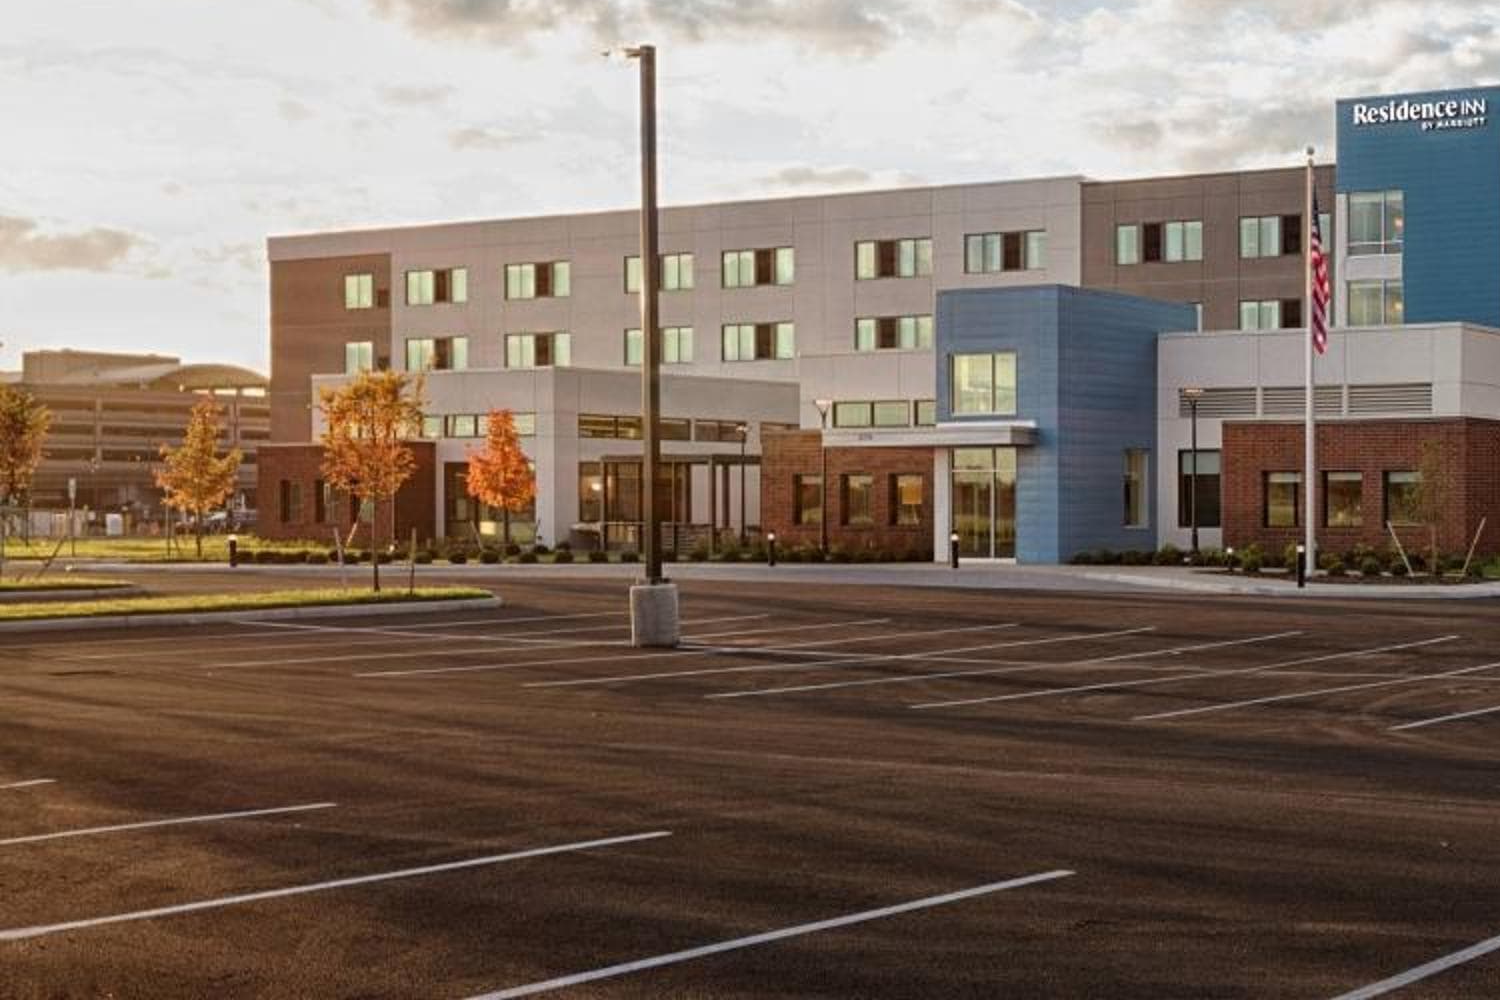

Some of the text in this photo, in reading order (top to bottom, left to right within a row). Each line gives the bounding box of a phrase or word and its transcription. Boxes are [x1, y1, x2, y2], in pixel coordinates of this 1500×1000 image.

[1353, 101, 1457, 125] Residence
[1421, 117, 1485, 131] BY MARRIOTT
